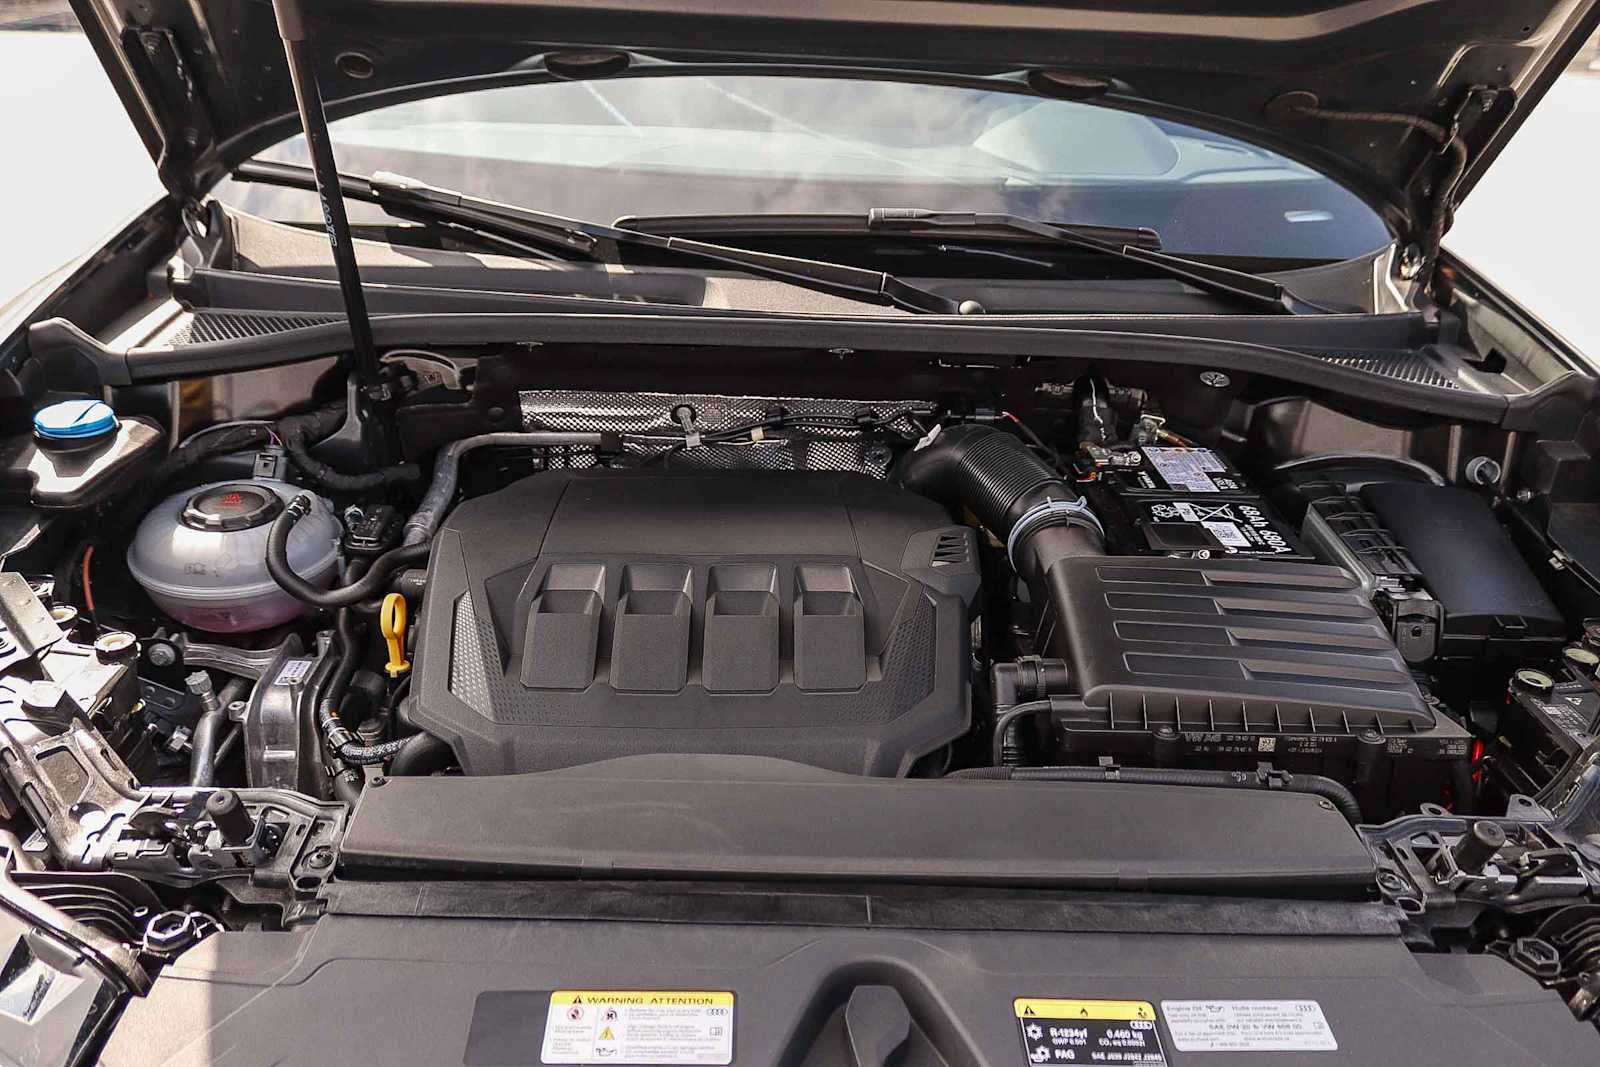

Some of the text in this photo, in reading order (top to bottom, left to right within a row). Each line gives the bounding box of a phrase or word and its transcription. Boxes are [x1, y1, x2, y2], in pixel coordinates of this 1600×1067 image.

[1238, 505, 1269, 527] 68Ah
[1259, 529, 1292, 553] 680A
[587, 997, 713, 1005] WARNING ATTENTION
[1050, 1027, 1088, 1039] R-1234yf
[1131, 1029, 1144, 1041] kg
[1055, 1049, 1075, 1060] PAG
